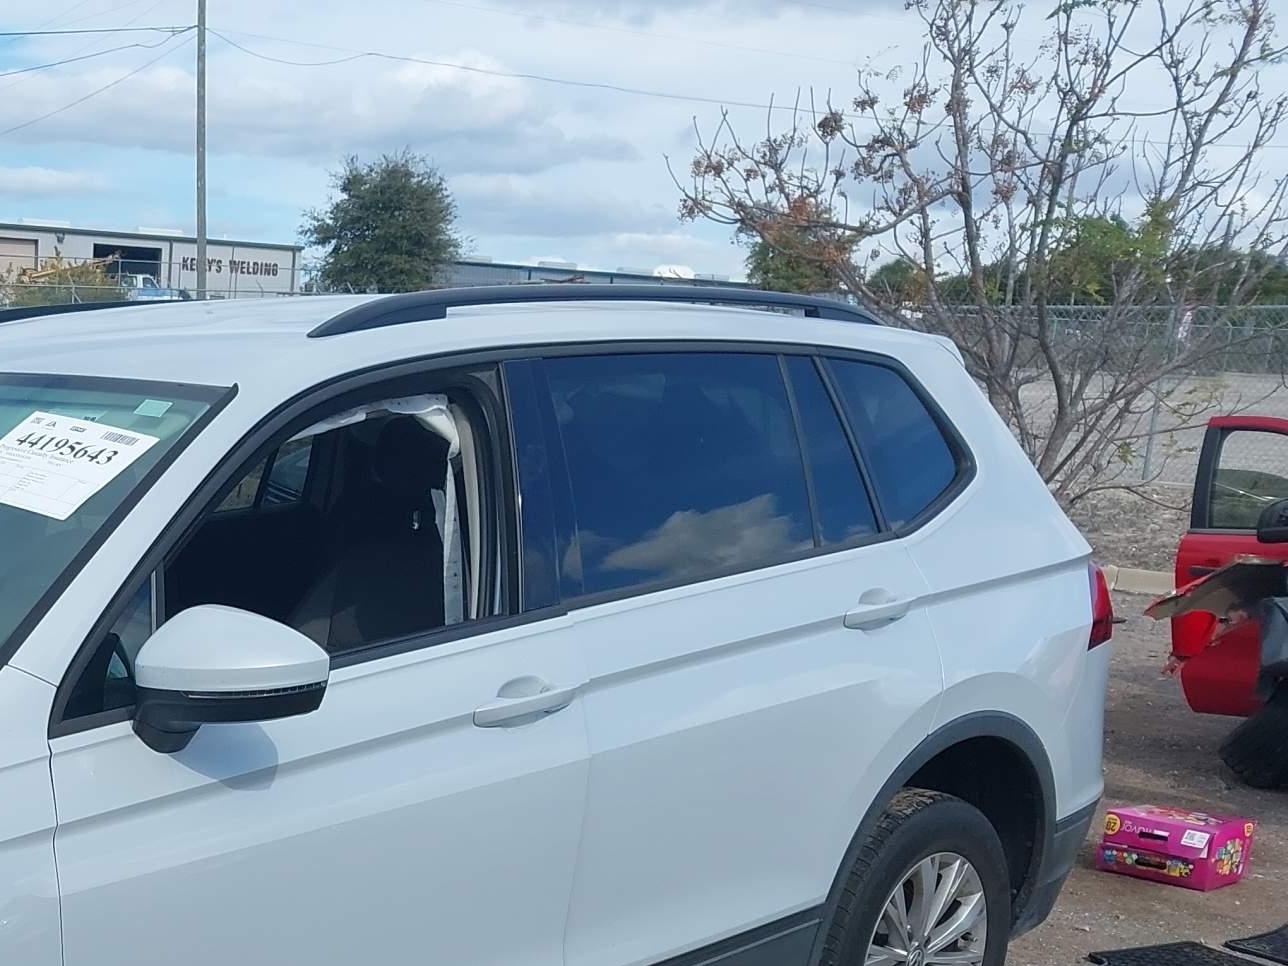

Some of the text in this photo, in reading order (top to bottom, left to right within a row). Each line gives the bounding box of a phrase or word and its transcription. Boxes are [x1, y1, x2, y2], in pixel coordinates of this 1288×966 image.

[181, 256, 279, 277] KEY'S WELDING
[15, 431, 119, 466] 44195643
